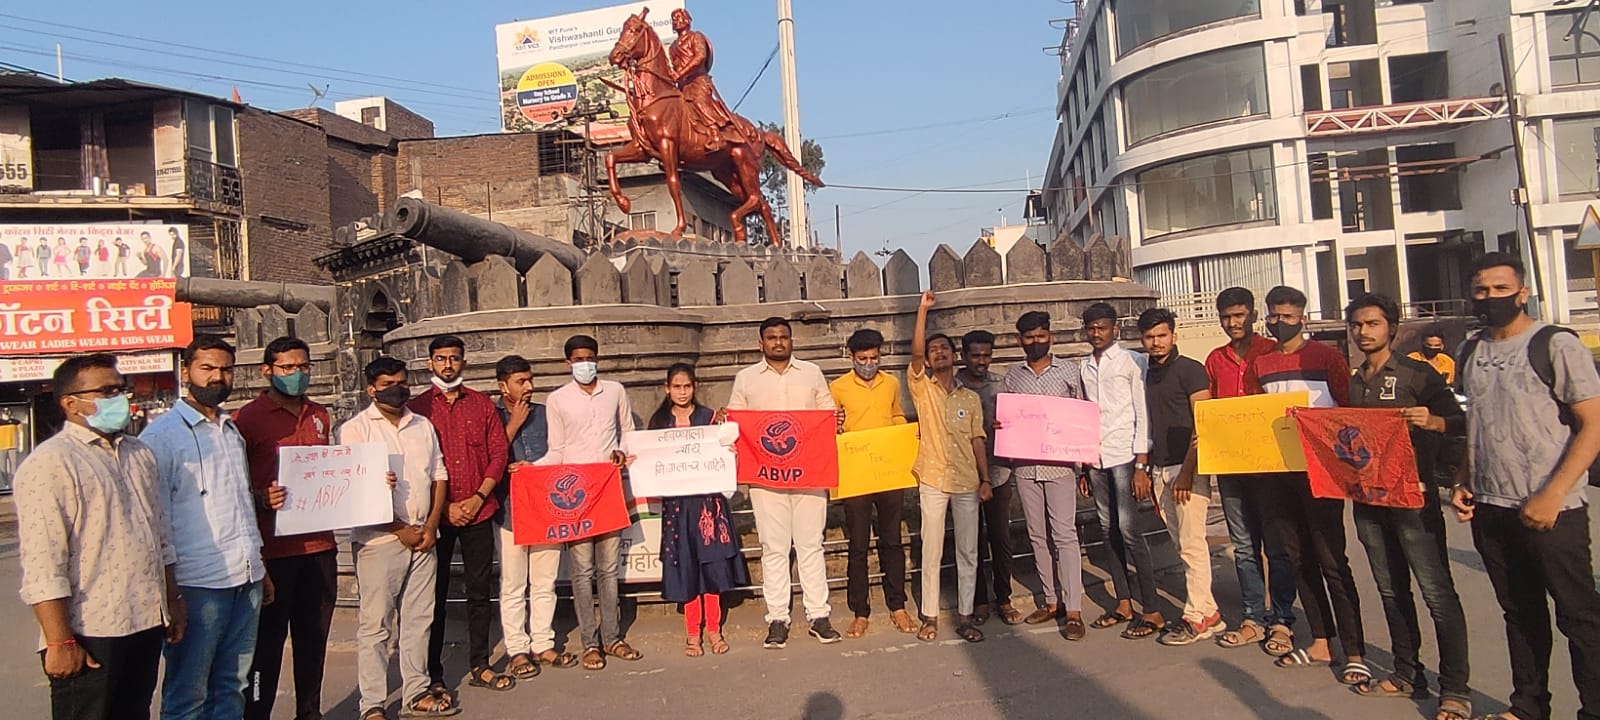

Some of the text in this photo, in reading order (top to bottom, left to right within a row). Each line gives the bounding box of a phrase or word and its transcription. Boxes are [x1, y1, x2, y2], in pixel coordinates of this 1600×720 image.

[549, 27, 604, 44] Vishwashanti
[606, 26, 621, 35] Gur
[649, 17, 672, 27] chool
[526, 70, 567, 81] ADMISSIONS
[537, 79, 556, 87] OPEN
[0, 302, 76, 336] ॉटन
[86, 295, 173, 333] सिटी
[0, 334, 175, 350] WEAR LADIES WEAR & KIDS WEAR
[757, 465, 804, 482] ABVP
[311, 478, 351, 513] ABVP
[546, 519, 593, 540] ABVP
